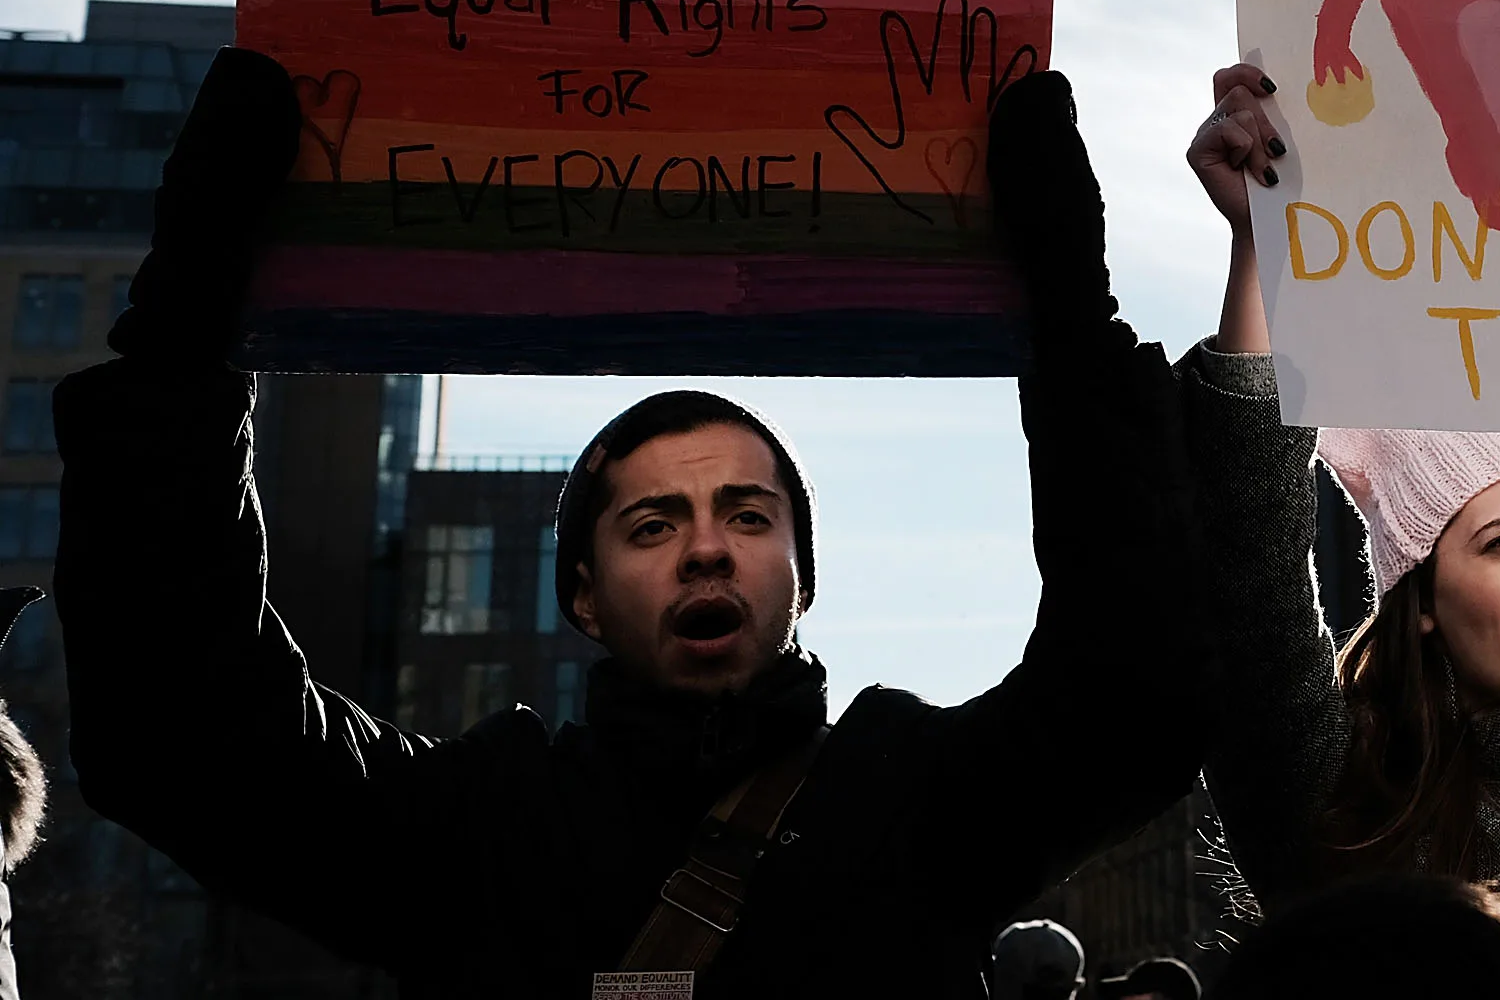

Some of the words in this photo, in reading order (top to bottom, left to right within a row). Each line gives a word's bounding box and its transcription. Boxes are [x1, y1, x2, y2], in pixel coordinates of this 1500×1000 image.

[388, 143, 822, 238] EVERYONE!
[596, 974, 638, 984] DEMAND
[640, 983, 691, 991] DIFFERENCES
